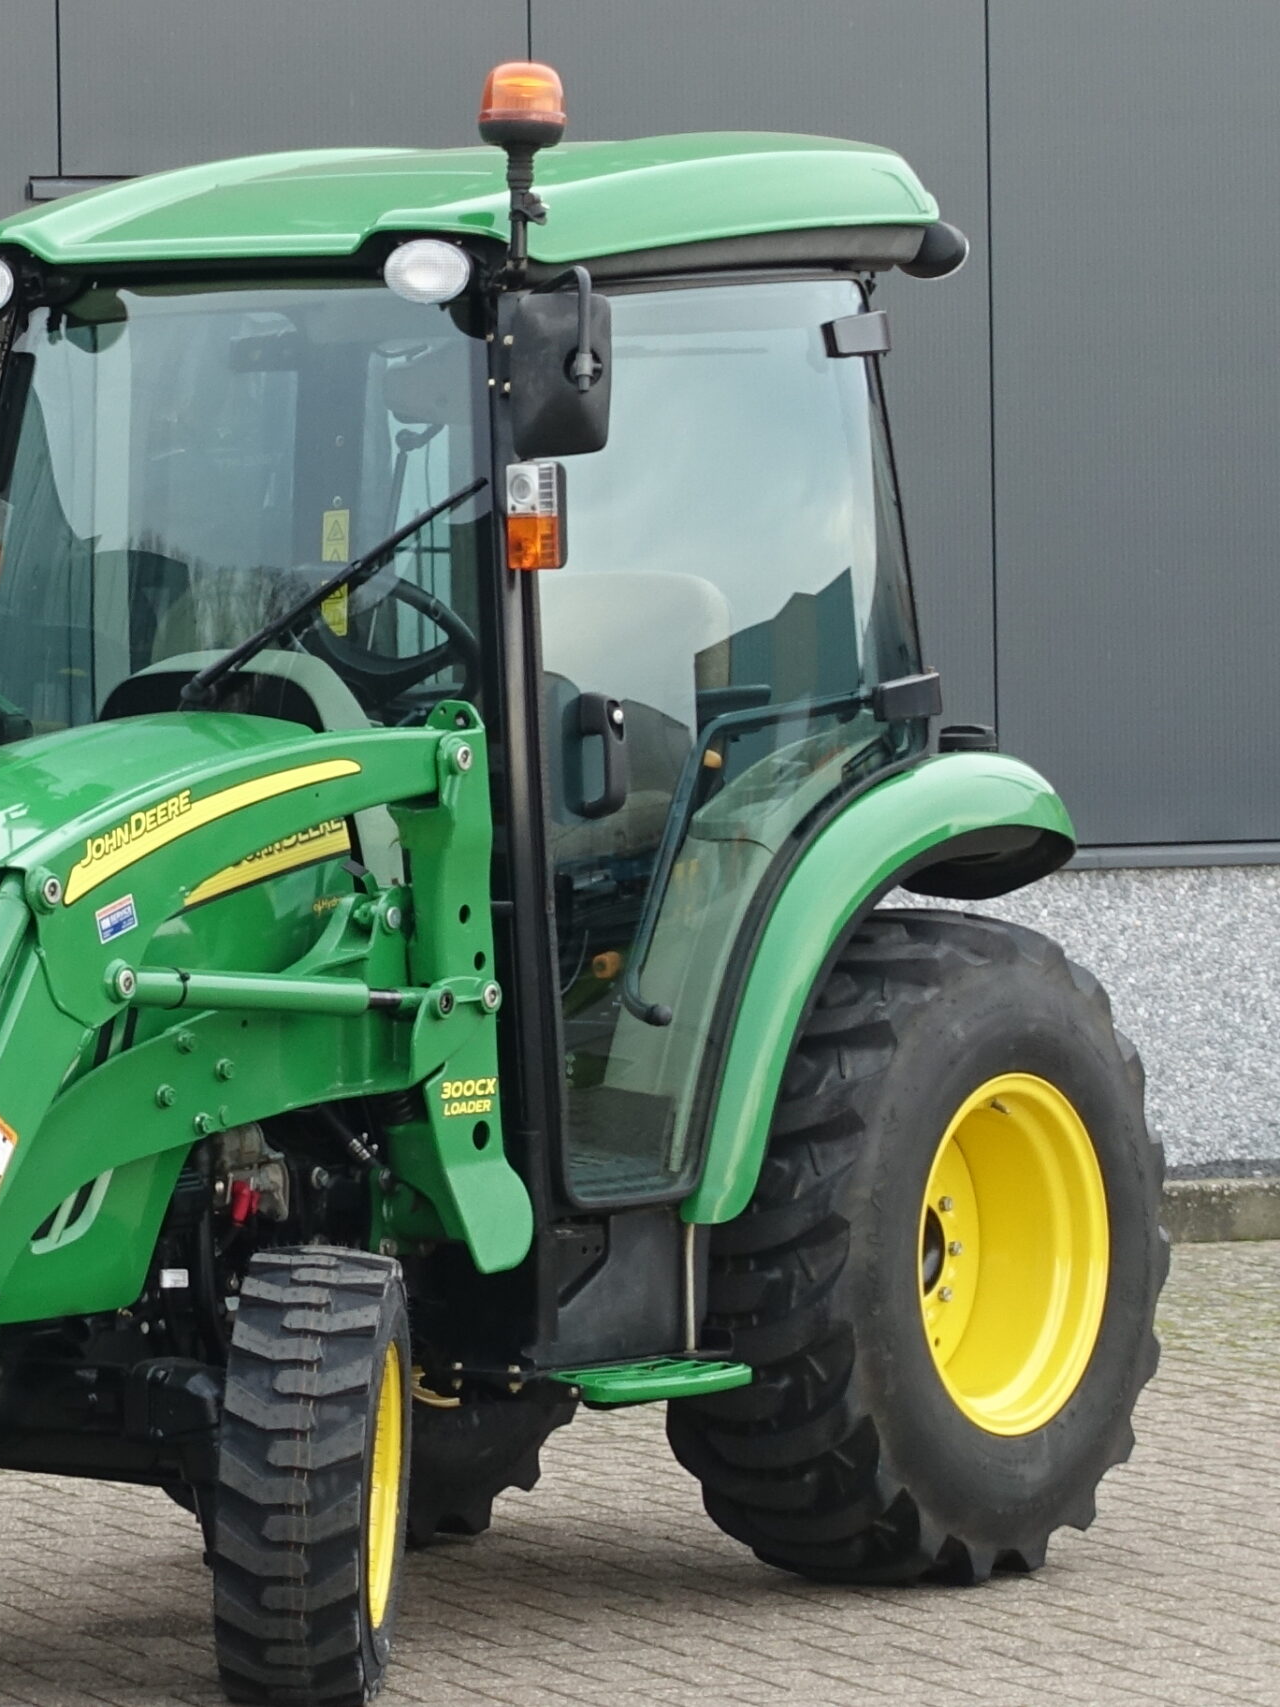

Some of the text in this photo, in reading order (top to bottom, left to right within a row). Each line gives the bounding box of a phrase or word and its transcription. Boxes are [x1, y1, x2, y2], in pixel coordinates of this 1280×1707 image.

[81, 788, 191, 868] JOHN DEERE
[440, 1077, 497, 1099] 300CX
[444, 1098, 491, 1116] LOADER
